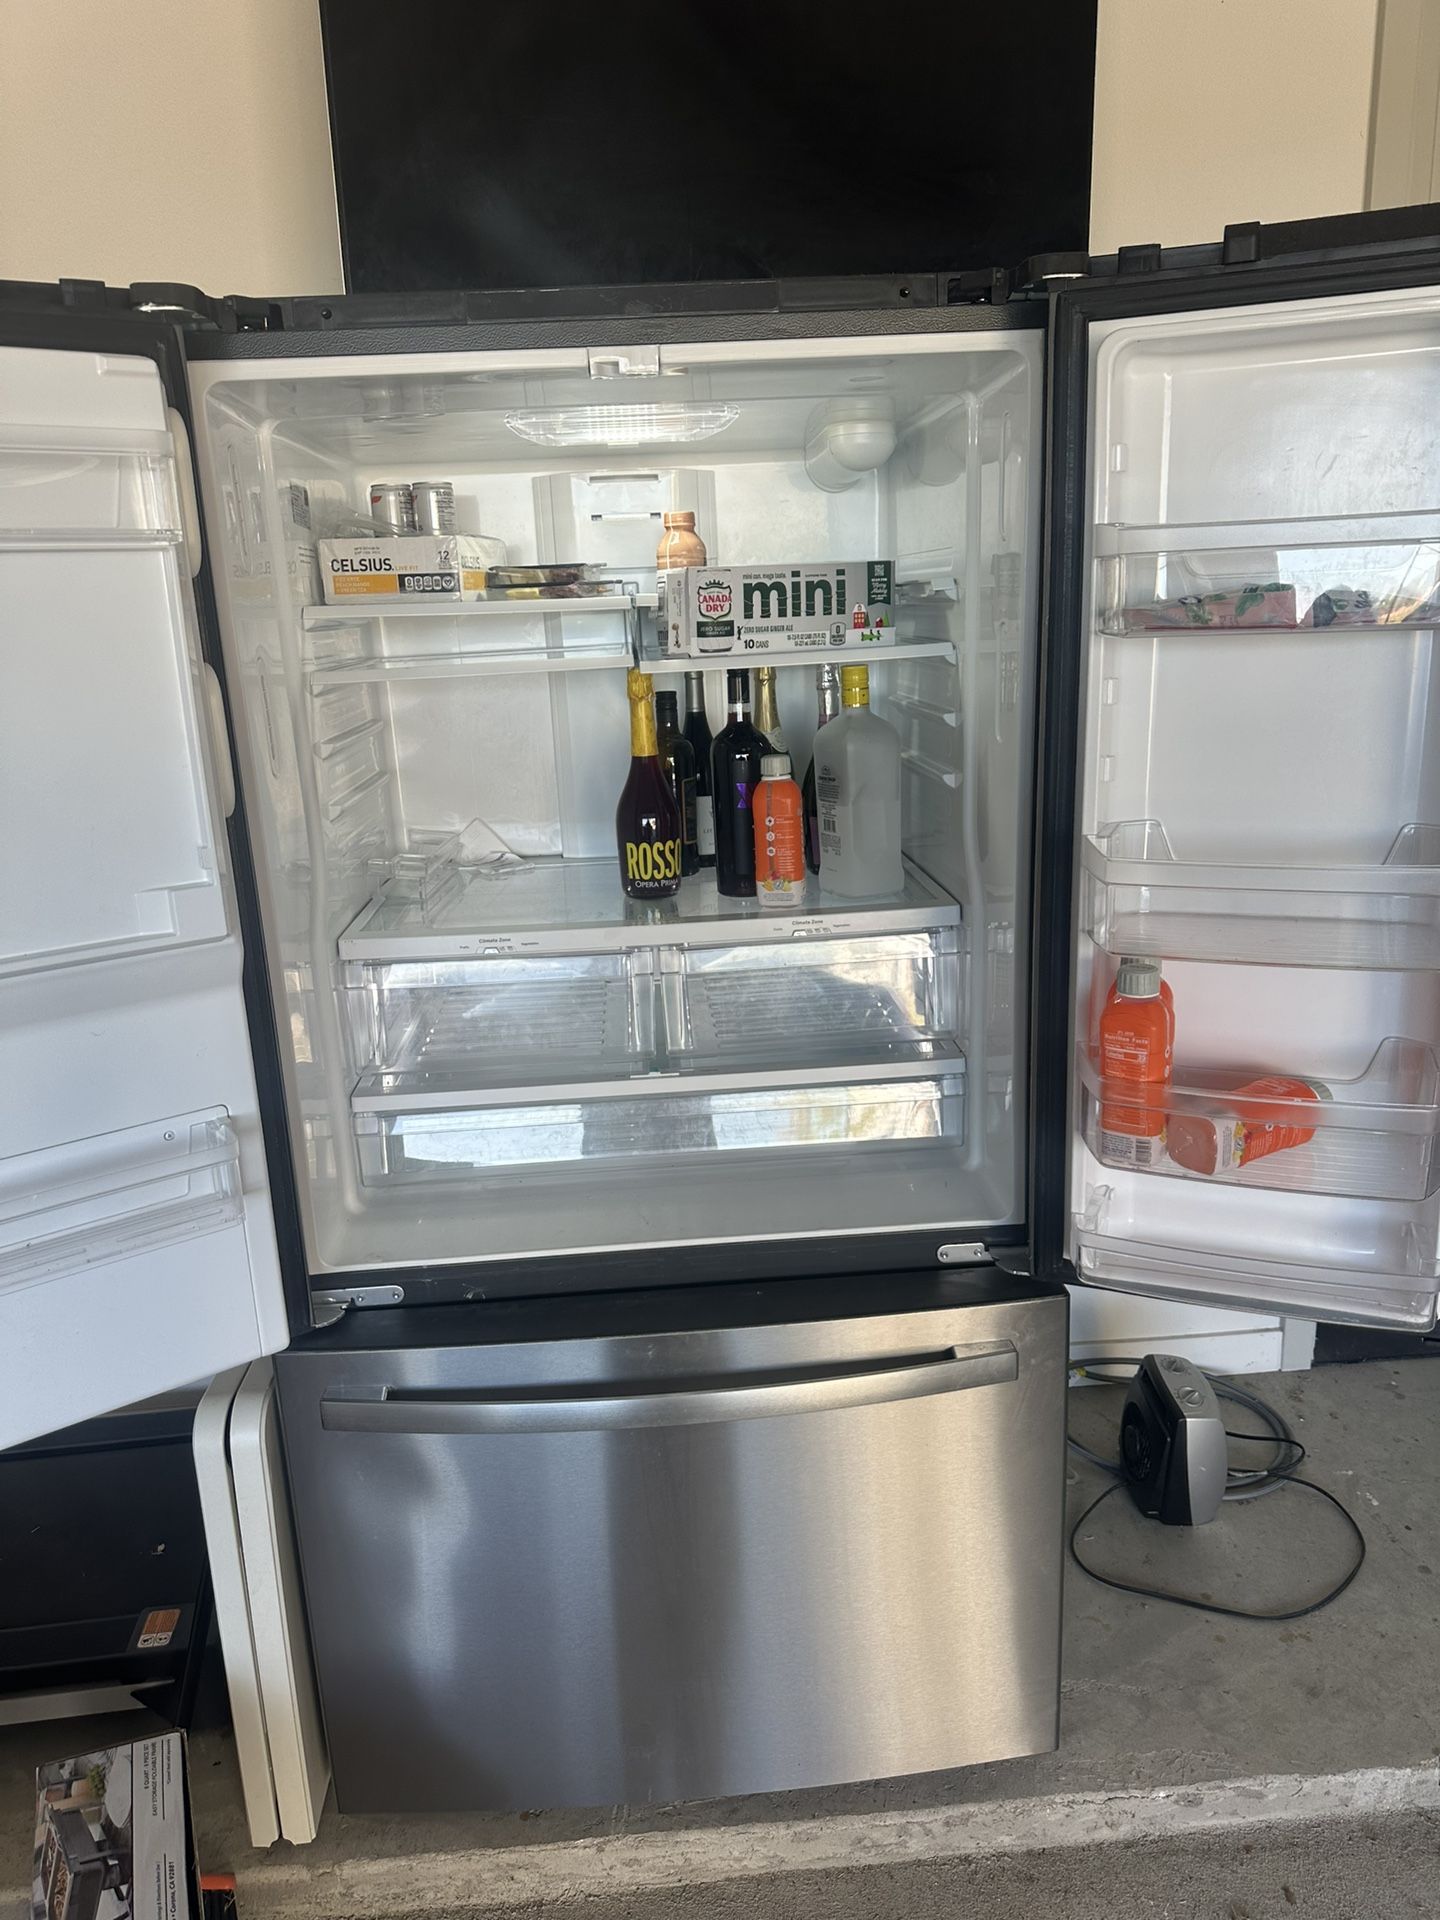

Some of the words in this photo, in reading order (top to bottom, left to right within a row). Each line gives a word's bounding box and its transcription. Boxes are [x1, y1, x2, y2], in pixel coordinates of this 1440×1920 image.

[438, 550, 450, 560] 12
[697, 593, 733, 605] CANADA
[743, 569, 847, 619] mini
[705, 603, 726, 613] DRY
[744, 639, 755, 649] 10
[755, 640, 770, 649] CANS
[626, 838, 682, 881] ROSSO
[169, 1881, 176, 1890] CA
